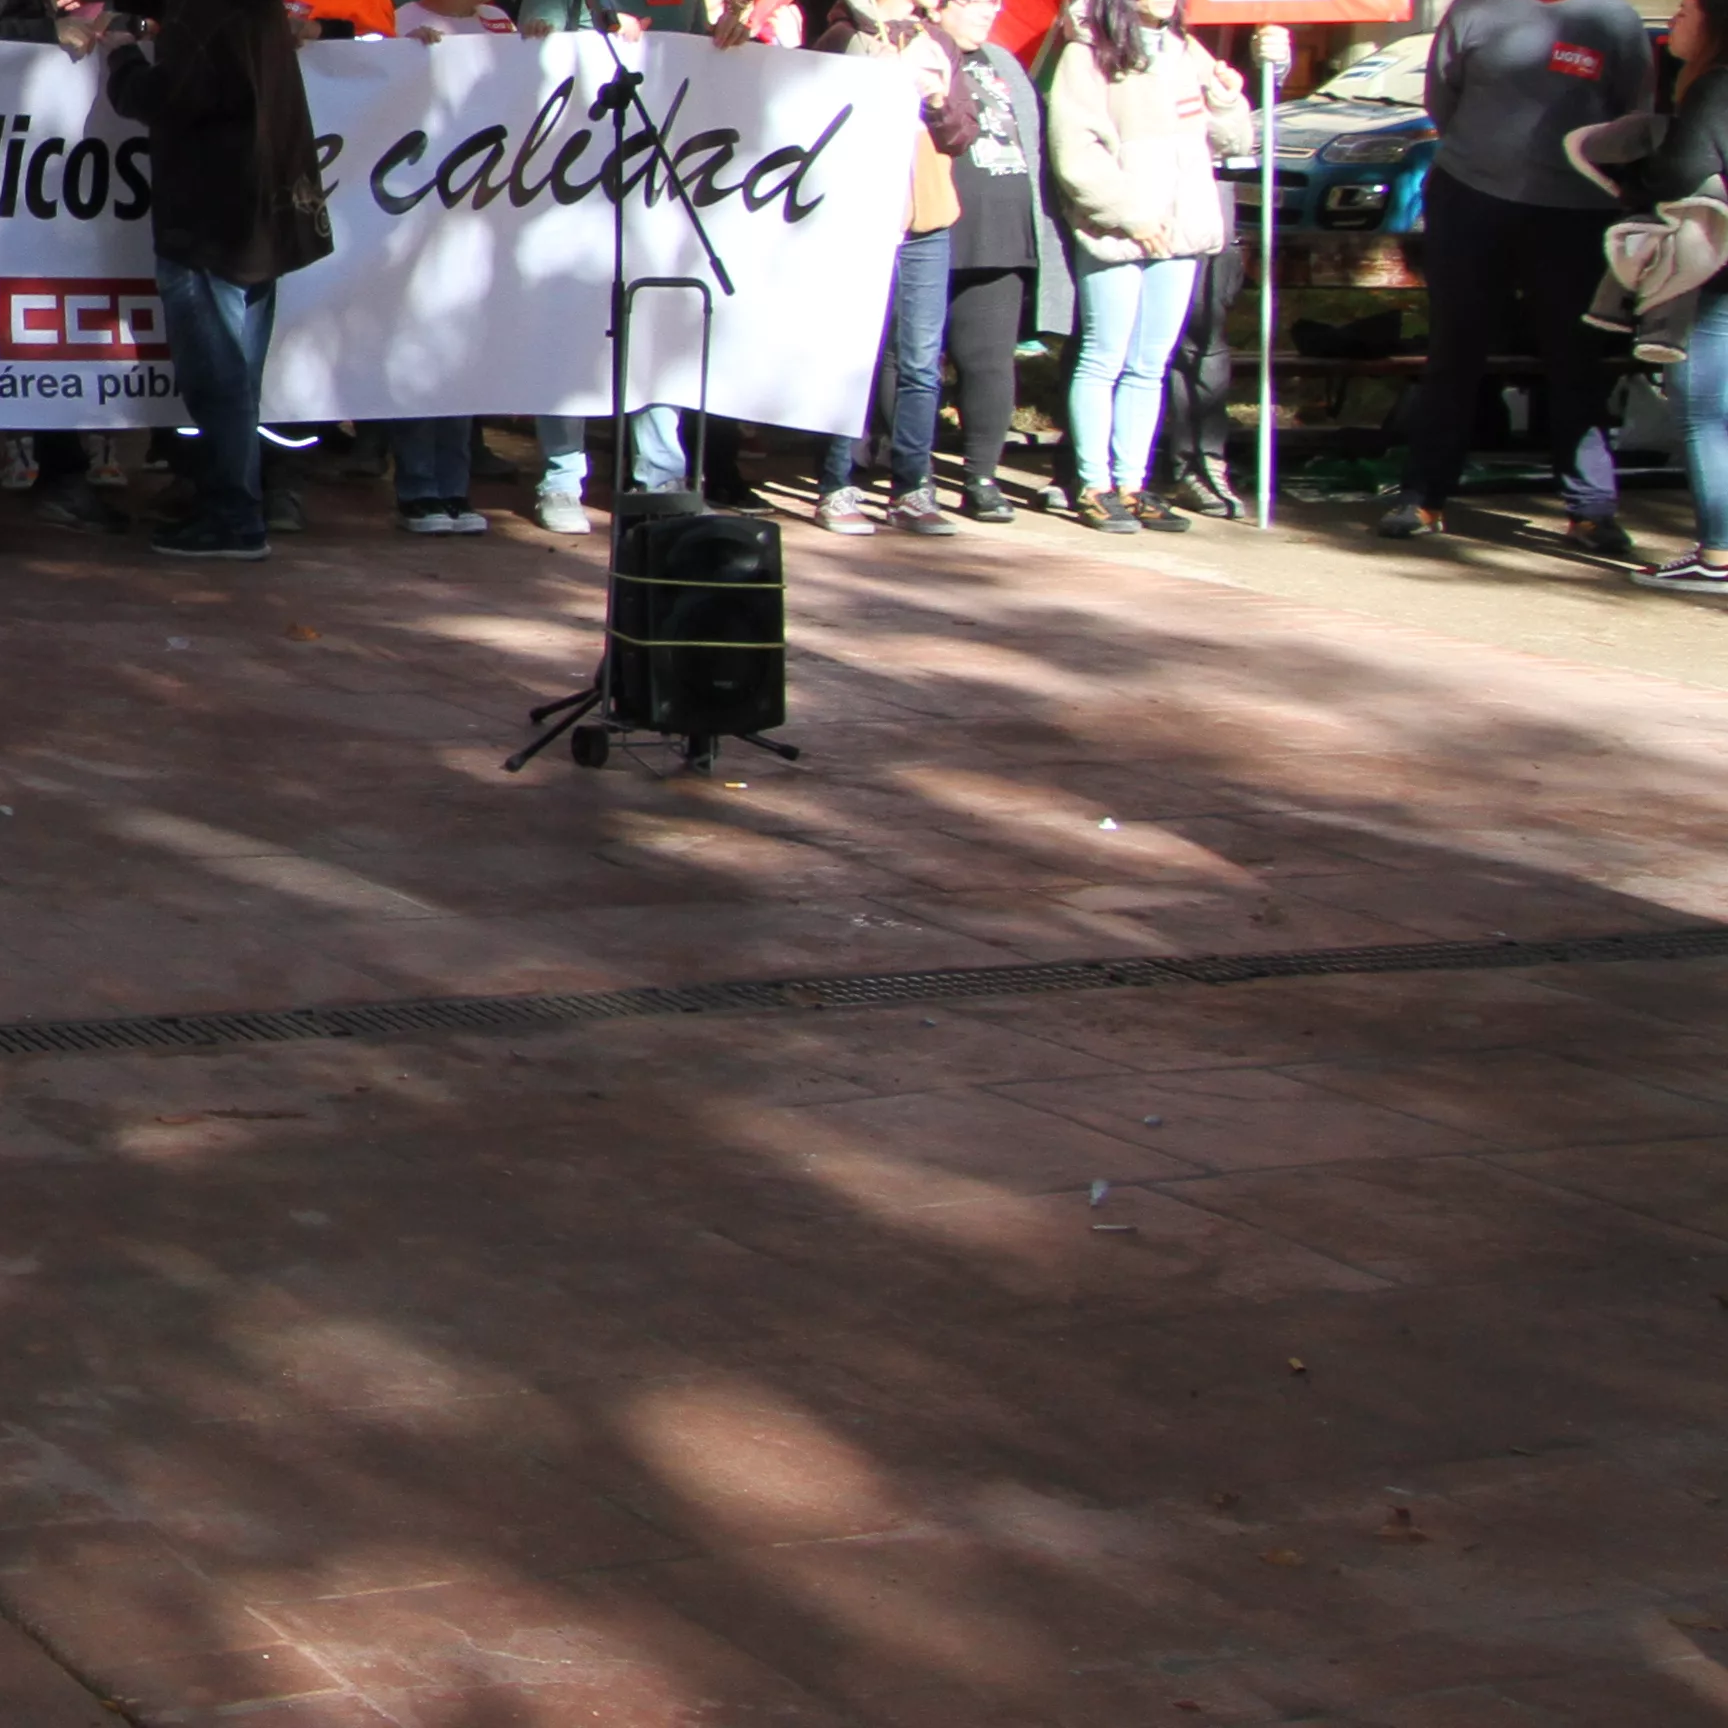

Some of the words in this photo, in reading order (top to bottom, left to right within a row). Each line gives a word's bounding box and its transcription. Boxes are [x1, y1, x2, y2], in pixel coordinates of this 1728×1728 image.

[369, 75, 854, 225] calidad
[10, 294, 168, 345] CCO
[97, 365, 180, 405] púb
